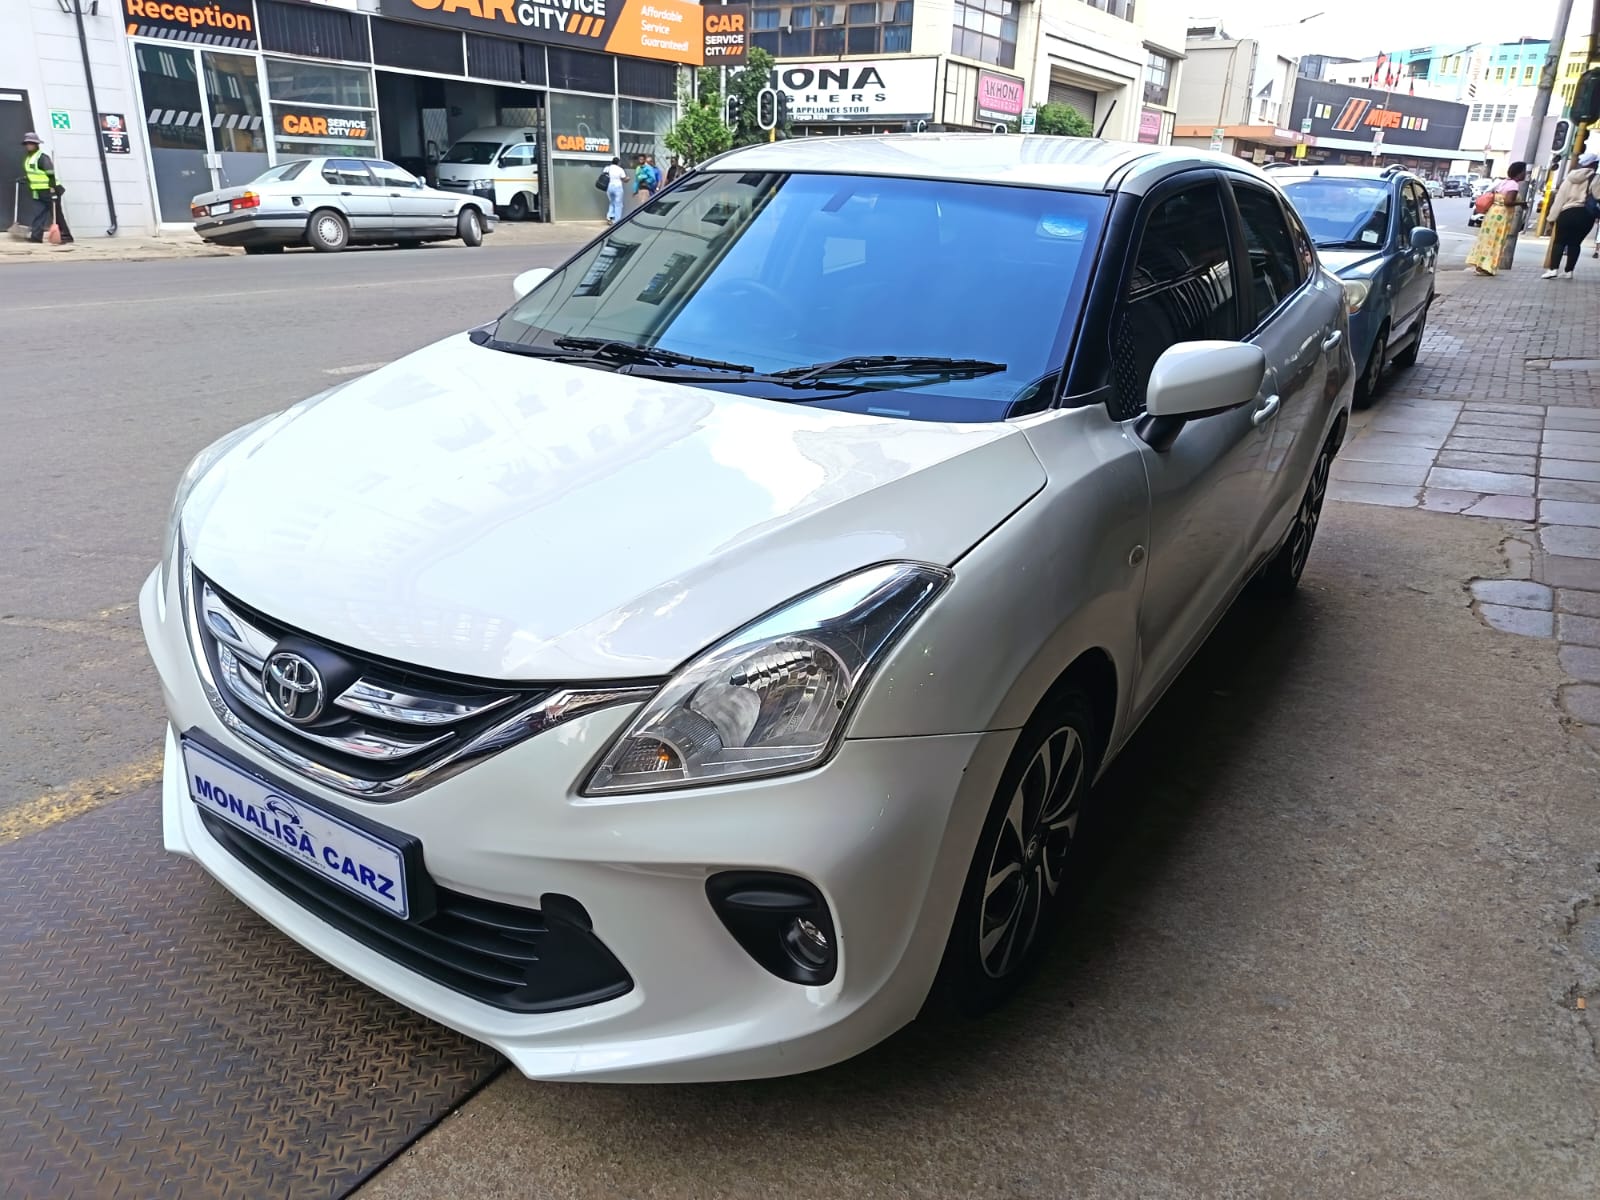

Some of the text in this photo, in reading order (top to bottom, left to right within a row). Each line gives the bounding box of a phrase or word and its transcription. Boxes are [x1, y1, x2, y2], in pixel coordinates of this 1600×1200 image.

[127, 0, 251, 31] Reception
[518, 3, 569, 32] CITY
[641, 5, 683, 22] Affordable
[641, 19, 670, 35] Service
[705, 14, 744, 32] CAR
[705, 34, 744, 45] SERVICE
[705, 46, 727, 56] CITY
[796, 106, 841, 114] APPLIANCE
[842, 105, 870, 114] STORE
[283, 114, 366, 135] CAR SERVICE
[328, 127, 350, 137] CITY
[557, 135, 585, 150] CAR
[195, 775, 396, 901] MONALISA CARZ
